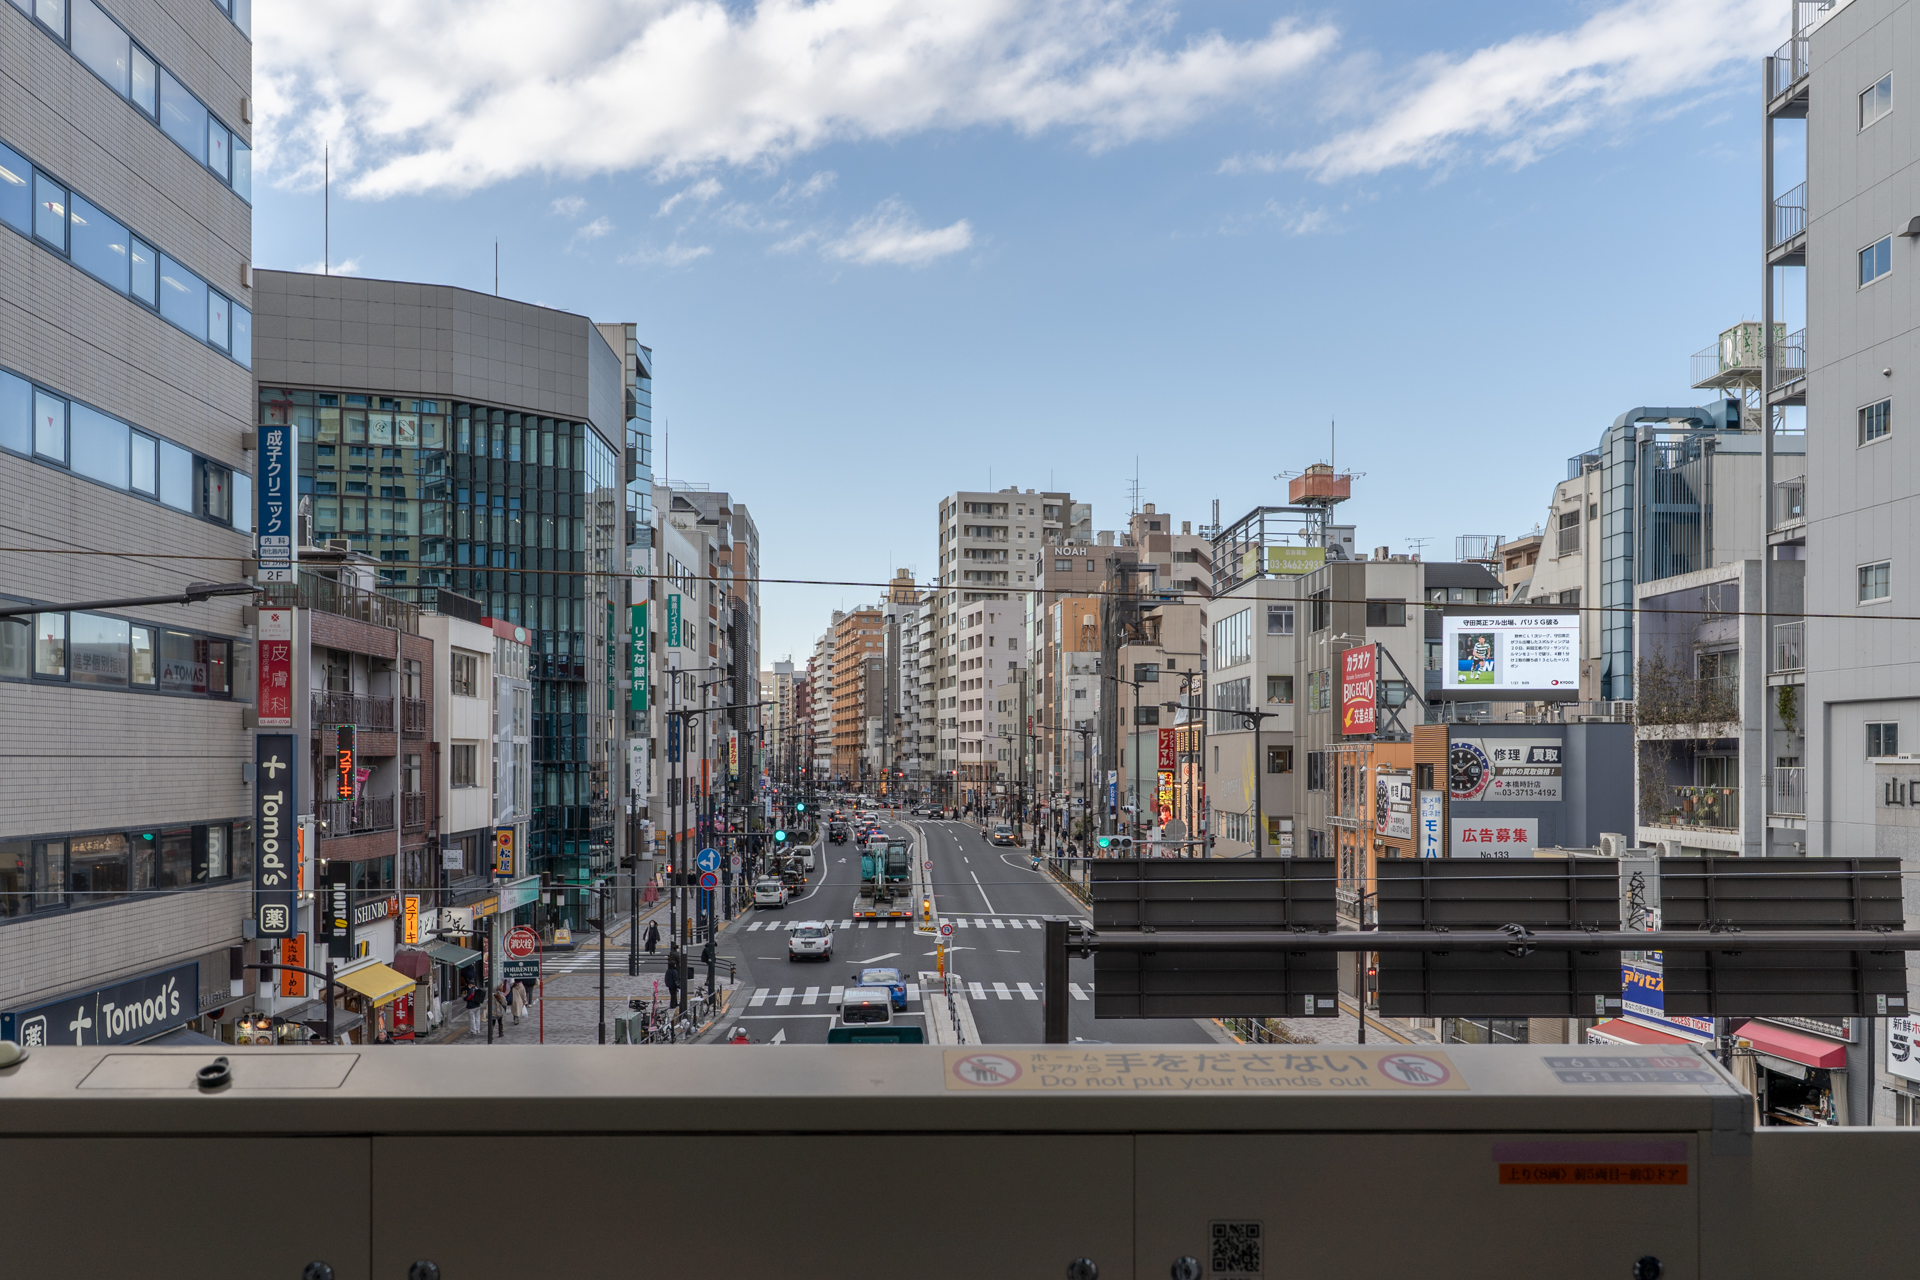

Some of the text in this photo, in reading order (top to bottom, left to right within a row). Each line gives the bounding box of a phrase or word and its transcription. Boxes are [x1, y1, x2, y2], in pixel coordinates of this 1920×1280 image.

[266, 430, 283, 533] 成子クリニック
[1054, 547, 1087, 556] NOAH
[1269, 559, 1323, 570] 03-3462-2933
[267, 571, 283, 580] 2F
[73, 652, 127, 675] 進学個別指導
[634, 626, 645, 691] りそな銀行
[1346, 651, 1371, 672] カラオケ
[174, 664, 204, 683] TOMAS
[271, 644, 288, 714] 皮膚科
[1343, 683, 1356, 704] BIG
[1355, 679, 1374, 700] ECHO
[1354, 707, 1374, 725] 交差点奥
[1160, 730, 1169, 766] ヒノマル
[1493, 748, 1558, 762] 修理 買取
[339, 750, 352, 797] ステーキ
[1502, 789, 1557, 797] 03-3713-4192
[1505, 780, 1541, 788] 本橋時計店
[1421, 797, 1428, 817] 宝石
[1434, 797, 1441, 817] 時計
[263, 790, 287, 886] Tomod's
[1425, 820, 1437, 858] モトハ
[1462, 828, 1528, 843] 広告募集
[499, 847, 512, 872] 松屋
[265, 908, 284, 929] 薬
[405, 898, 417, 944] ステーキ
[444, 910, 469, 936] うどん
[510, 939, 533, 949] 消火栓
[102, 976, 180, 1038] Tomod's
[1670, 1016, 1711, 1033] ACCESS TICKET
[25, 1024, 42, 1046] 薬
[1030, 1053, 1099, 1062] ホーム
[1104, 1053, 1369, 1073] 手をださない
[1031, 1064, 1102, 1073] ドアから
[1041, 1075, 1371, 1090] Do not put your hands out
